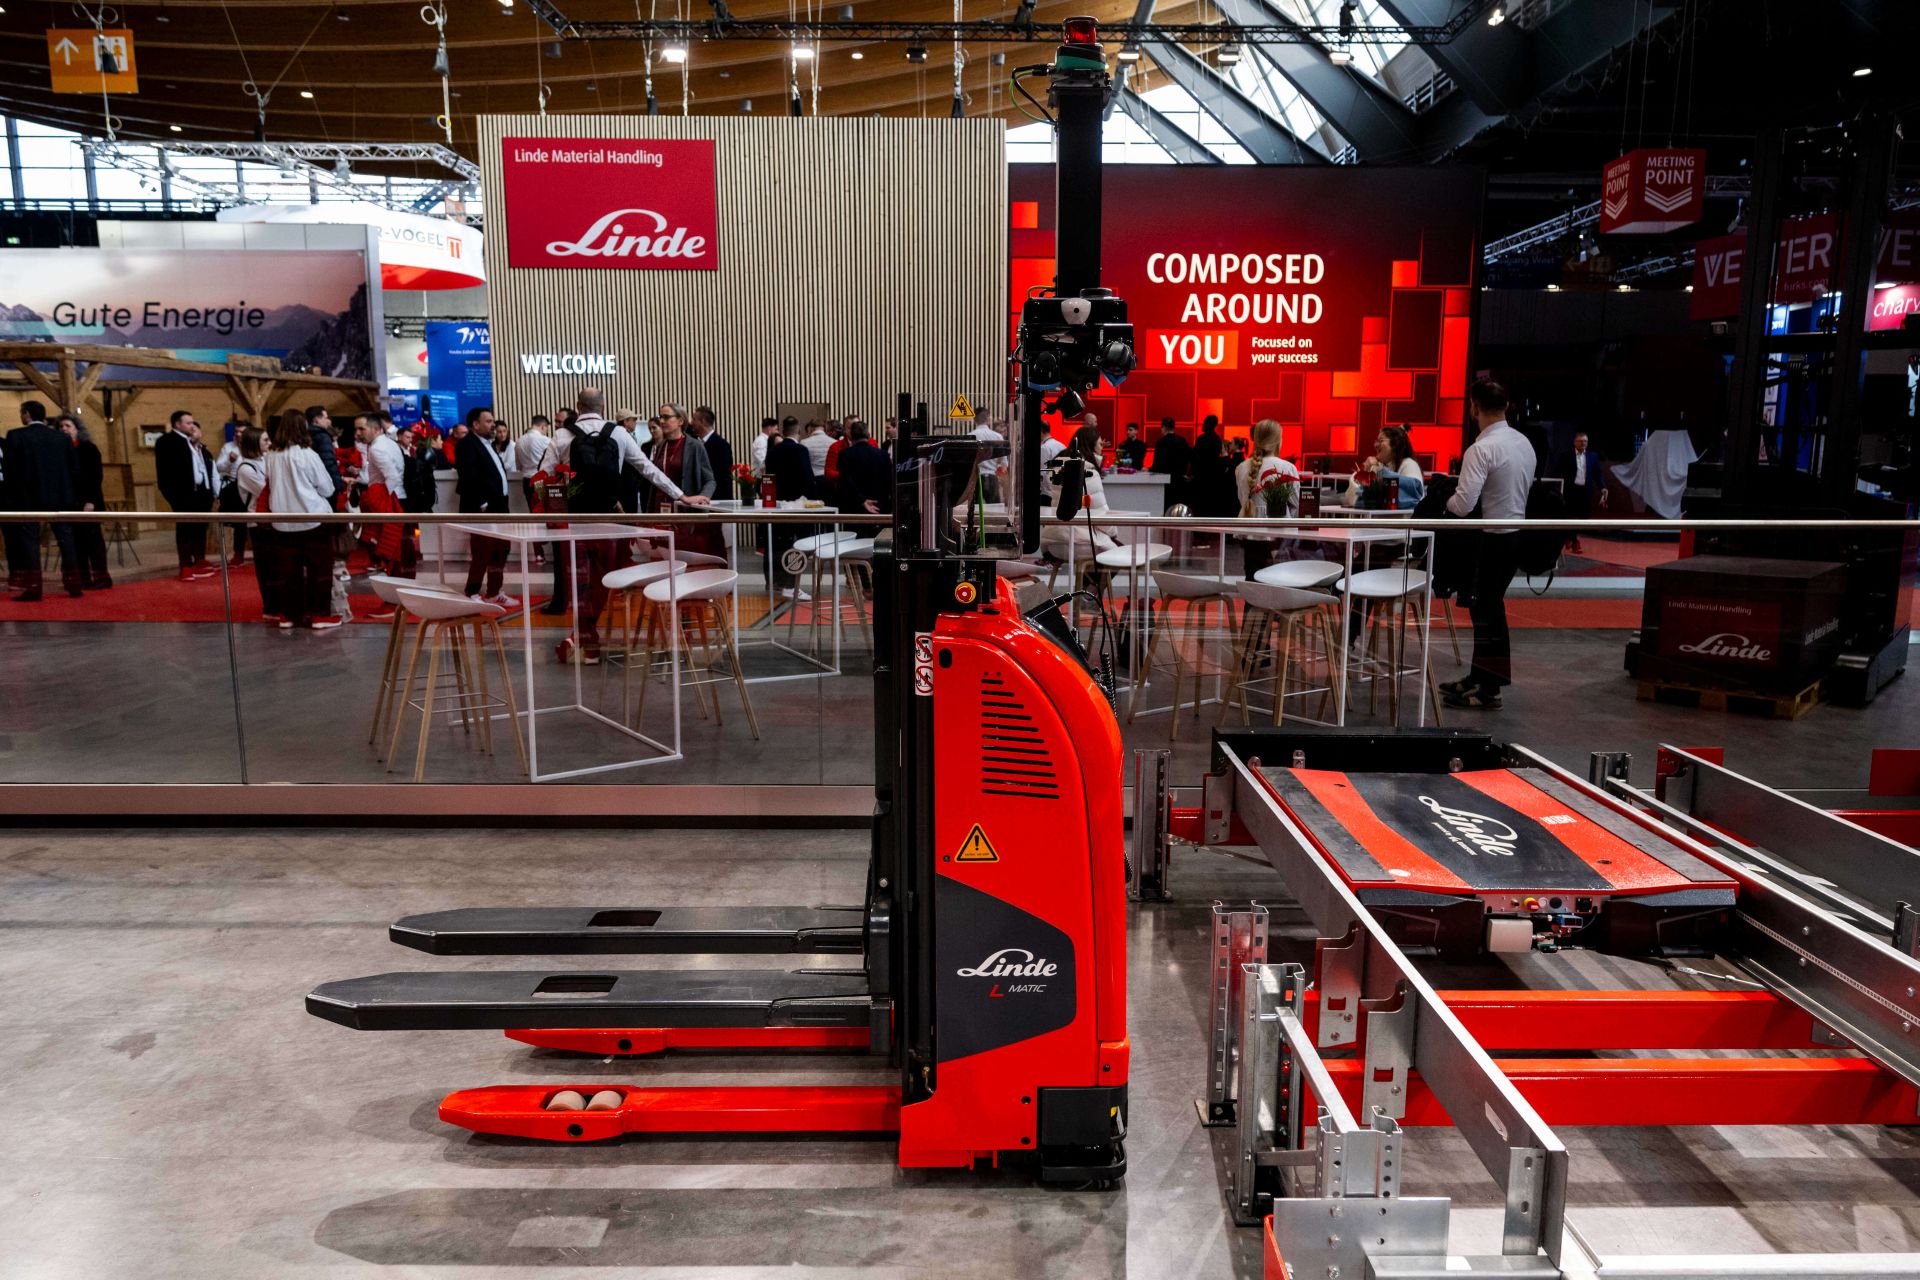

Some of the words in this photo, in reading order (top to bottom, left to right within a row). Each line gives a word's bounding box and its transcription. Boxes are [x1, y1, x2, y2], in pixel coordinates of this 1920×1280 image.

[514, 149, 548, 163] Linde
[551, 150, 604, 164] Material
[607, 151, 663, 168] Handling
[1607, 160, 1630, 180] MEETING
[1647, 156, 1695, 168] MEETING
[1606, 173, 1629, 196] POINT
[1645, 169, 1694, 184] POINT
[546, 208, 706, 258] Linde
[1146, 252, 1325, 284] COMPOSED
[53, 302, 132, 327] Gute
[143, 300, 265, 336] Energie
[1181, 293, 1323, 324] AROUND
[1160, 334, 1224, 365] YOU
[1251, 336, 1296, 348] Focused
[1298, 338, 1312, 348] on
[1251, 354, 1276, 365] your
[1278, 353, 1318, 364] success
[521, 354, 616, 375] WELCOME
[1668, 600, 1687, 609] Linde
[1688, 601, 1718, 612] Material
[1719, 604, 1752, 616] Handling
[1678, 633, 1771, 662] Linde
[1418, 795, 1518, 856] Linde
[957, 948, 1058, 977] Linde
[988, 984, 1005, 998] L
[1008, 984, 1047, 993] MATIC
